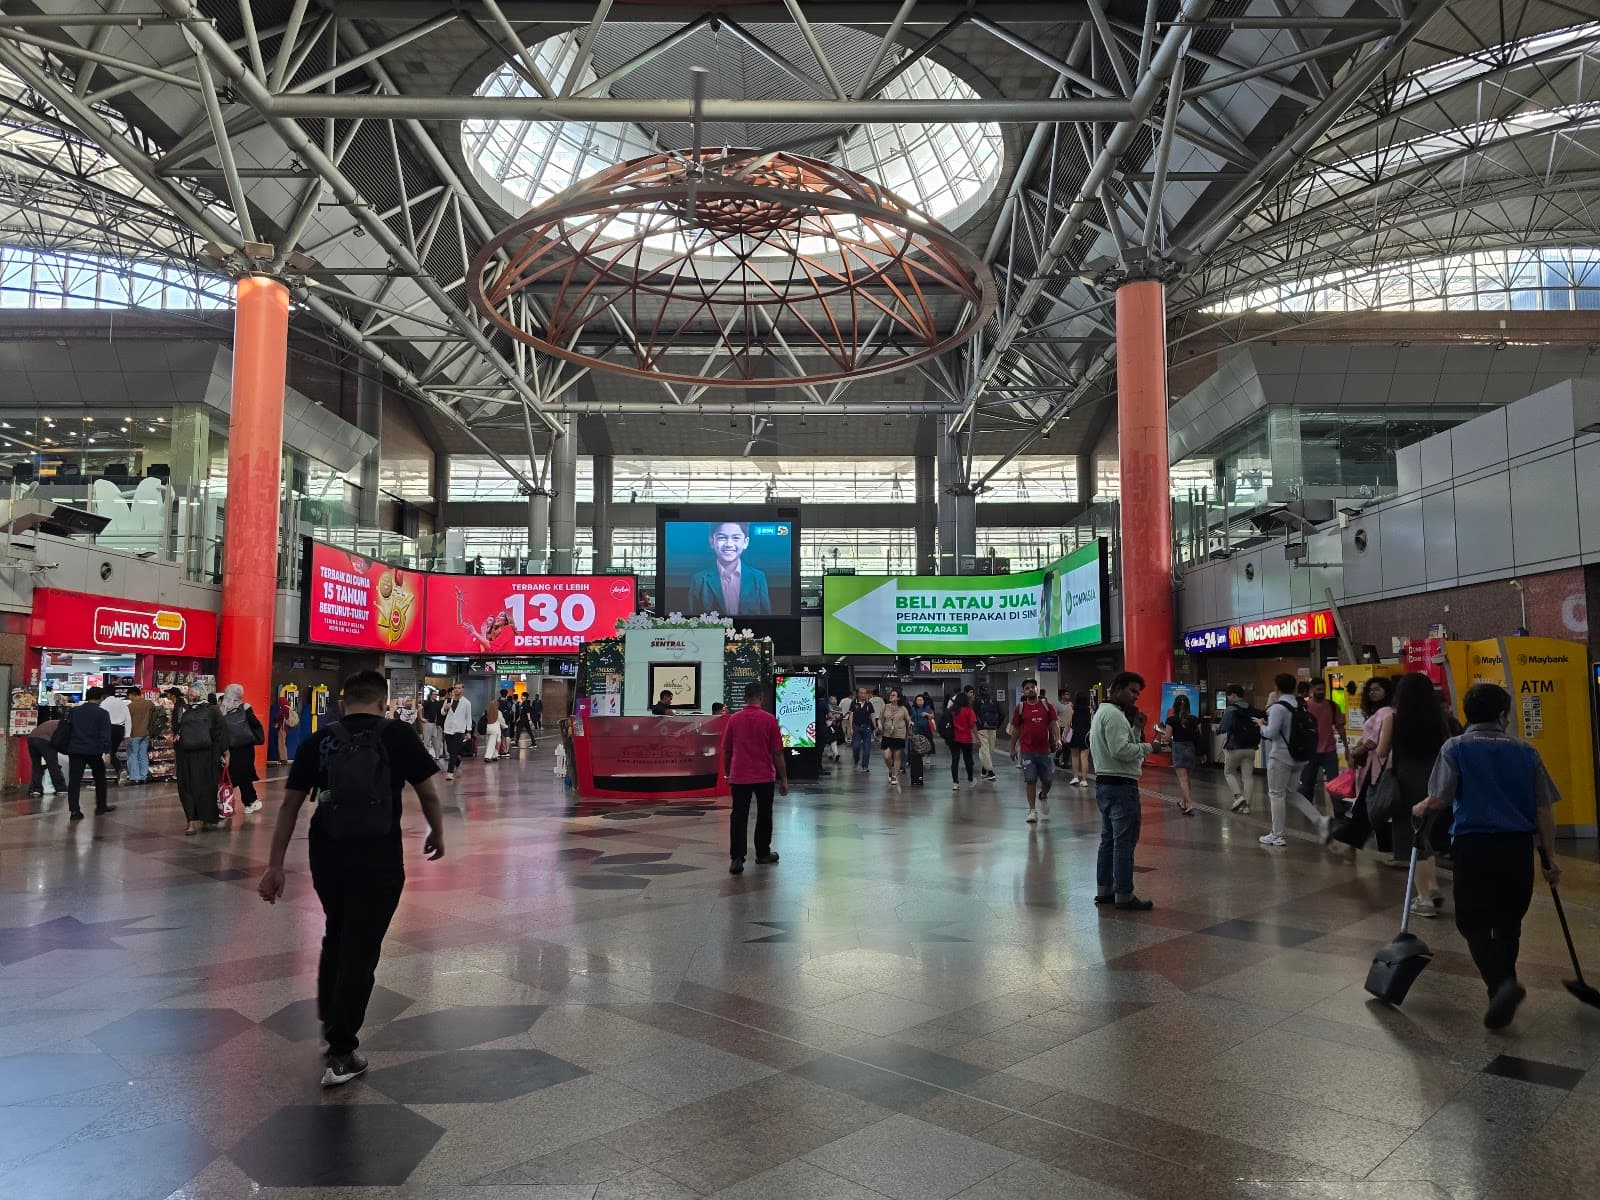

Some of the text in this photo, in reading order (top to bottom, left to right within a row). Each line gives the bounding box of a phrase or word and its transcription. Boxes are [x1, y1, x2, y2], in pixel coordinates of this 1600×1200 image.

[320, 566, 346, 582] TERBAIK
[346, 572, 353, 585] DI
[353, 576, 371, 589] DUNIA
[323, 581, 367, 607] 15 TAHUN
[896, 592, 1037, 609] BELI ATAU JUAL
[319, 601, 370, 621] BERTURUT-TURUT
[504, 593, 596, 632] 130
[896, 612, 946, 621] PERANTI
[949, 611, 1006, 621] TERPAKAI
[1009, 611, 1020, 620] DI
[100, 620, 170, 641] myNEWS.com
[901, 625, 963, 634] LOT 7A, ARAS 1
[1244, 617, 1307, 643] McDonald's
[515, 635, 585, 647] DESTINASI
[650, 640, 686, 648] SENTRAL
[1205, 631, 1217, 648] 24
[1528, 655, 1569, 664] Maybank
[1520, 680, 1554, 693] ATM
